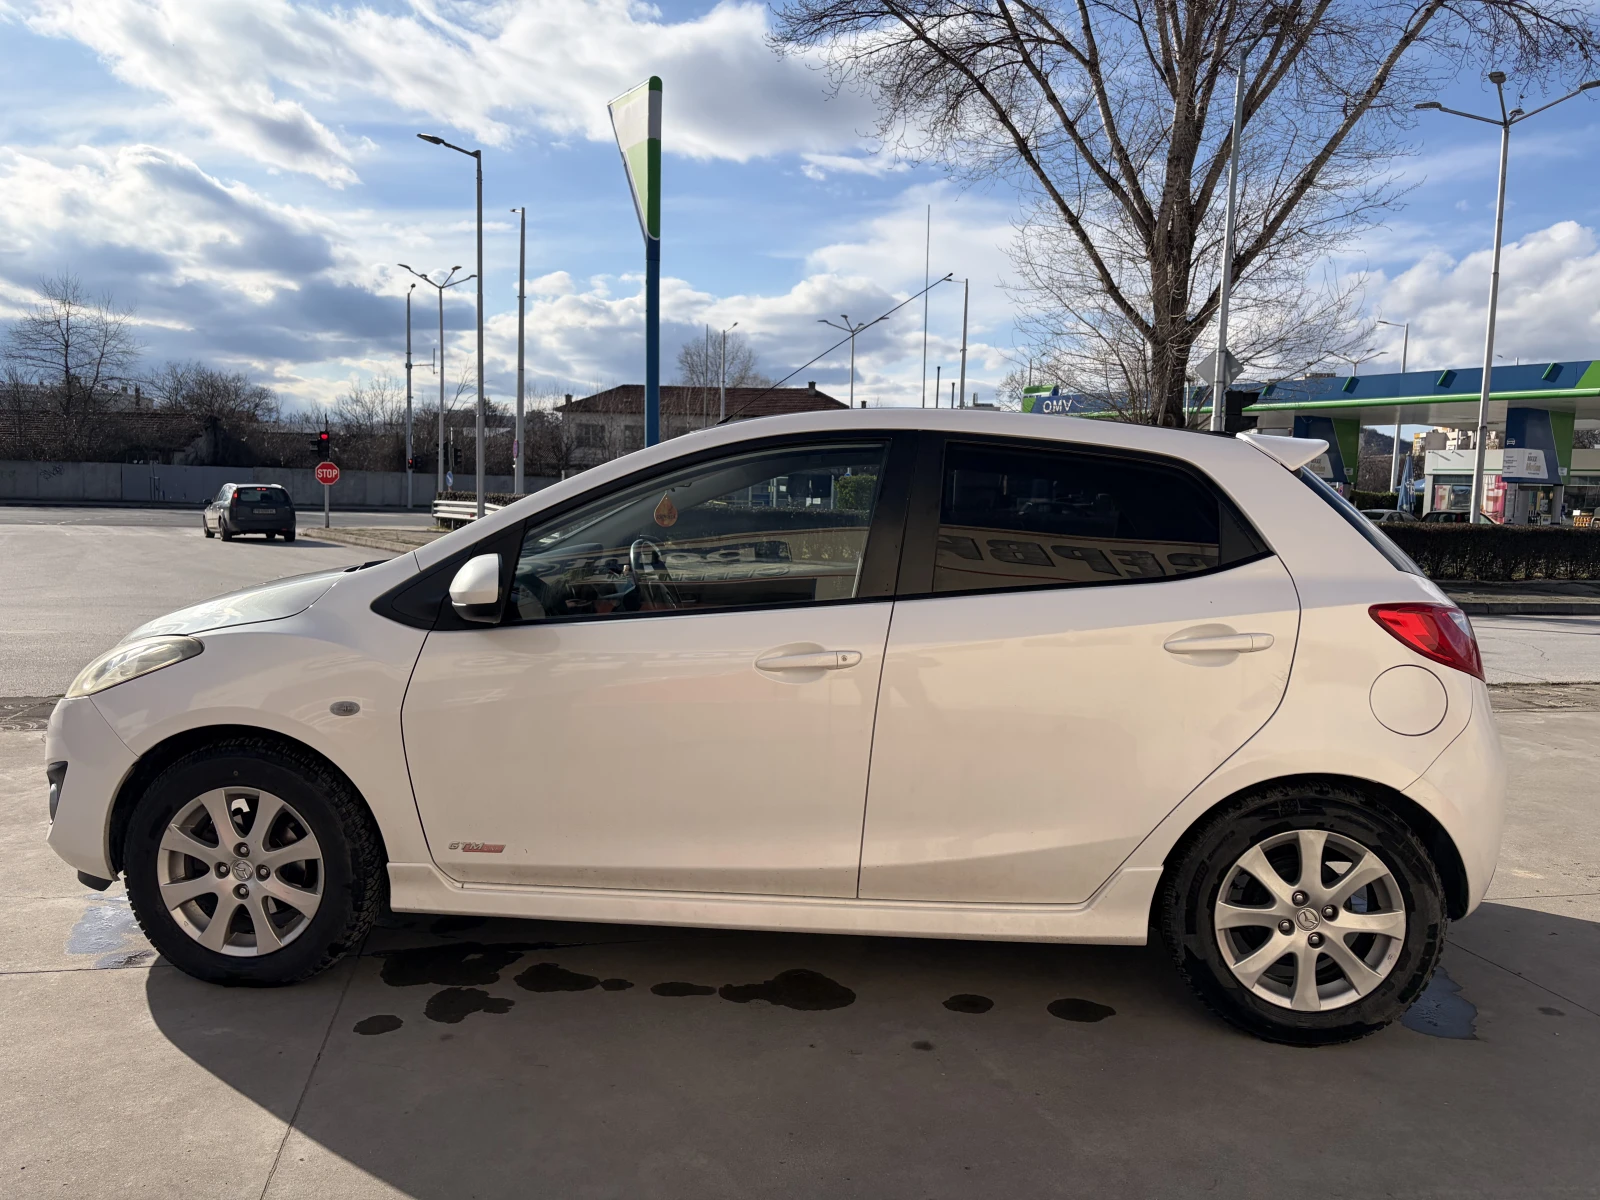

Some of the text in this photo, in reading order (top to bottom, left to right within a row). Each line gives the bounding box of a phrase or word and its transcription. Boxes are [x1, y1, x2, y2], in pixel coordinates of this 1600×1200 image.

[1043, 399, 1072, 412] OMV
[317, 469, 338, 478] STOP
[448, 841, 485, 850] GTM
